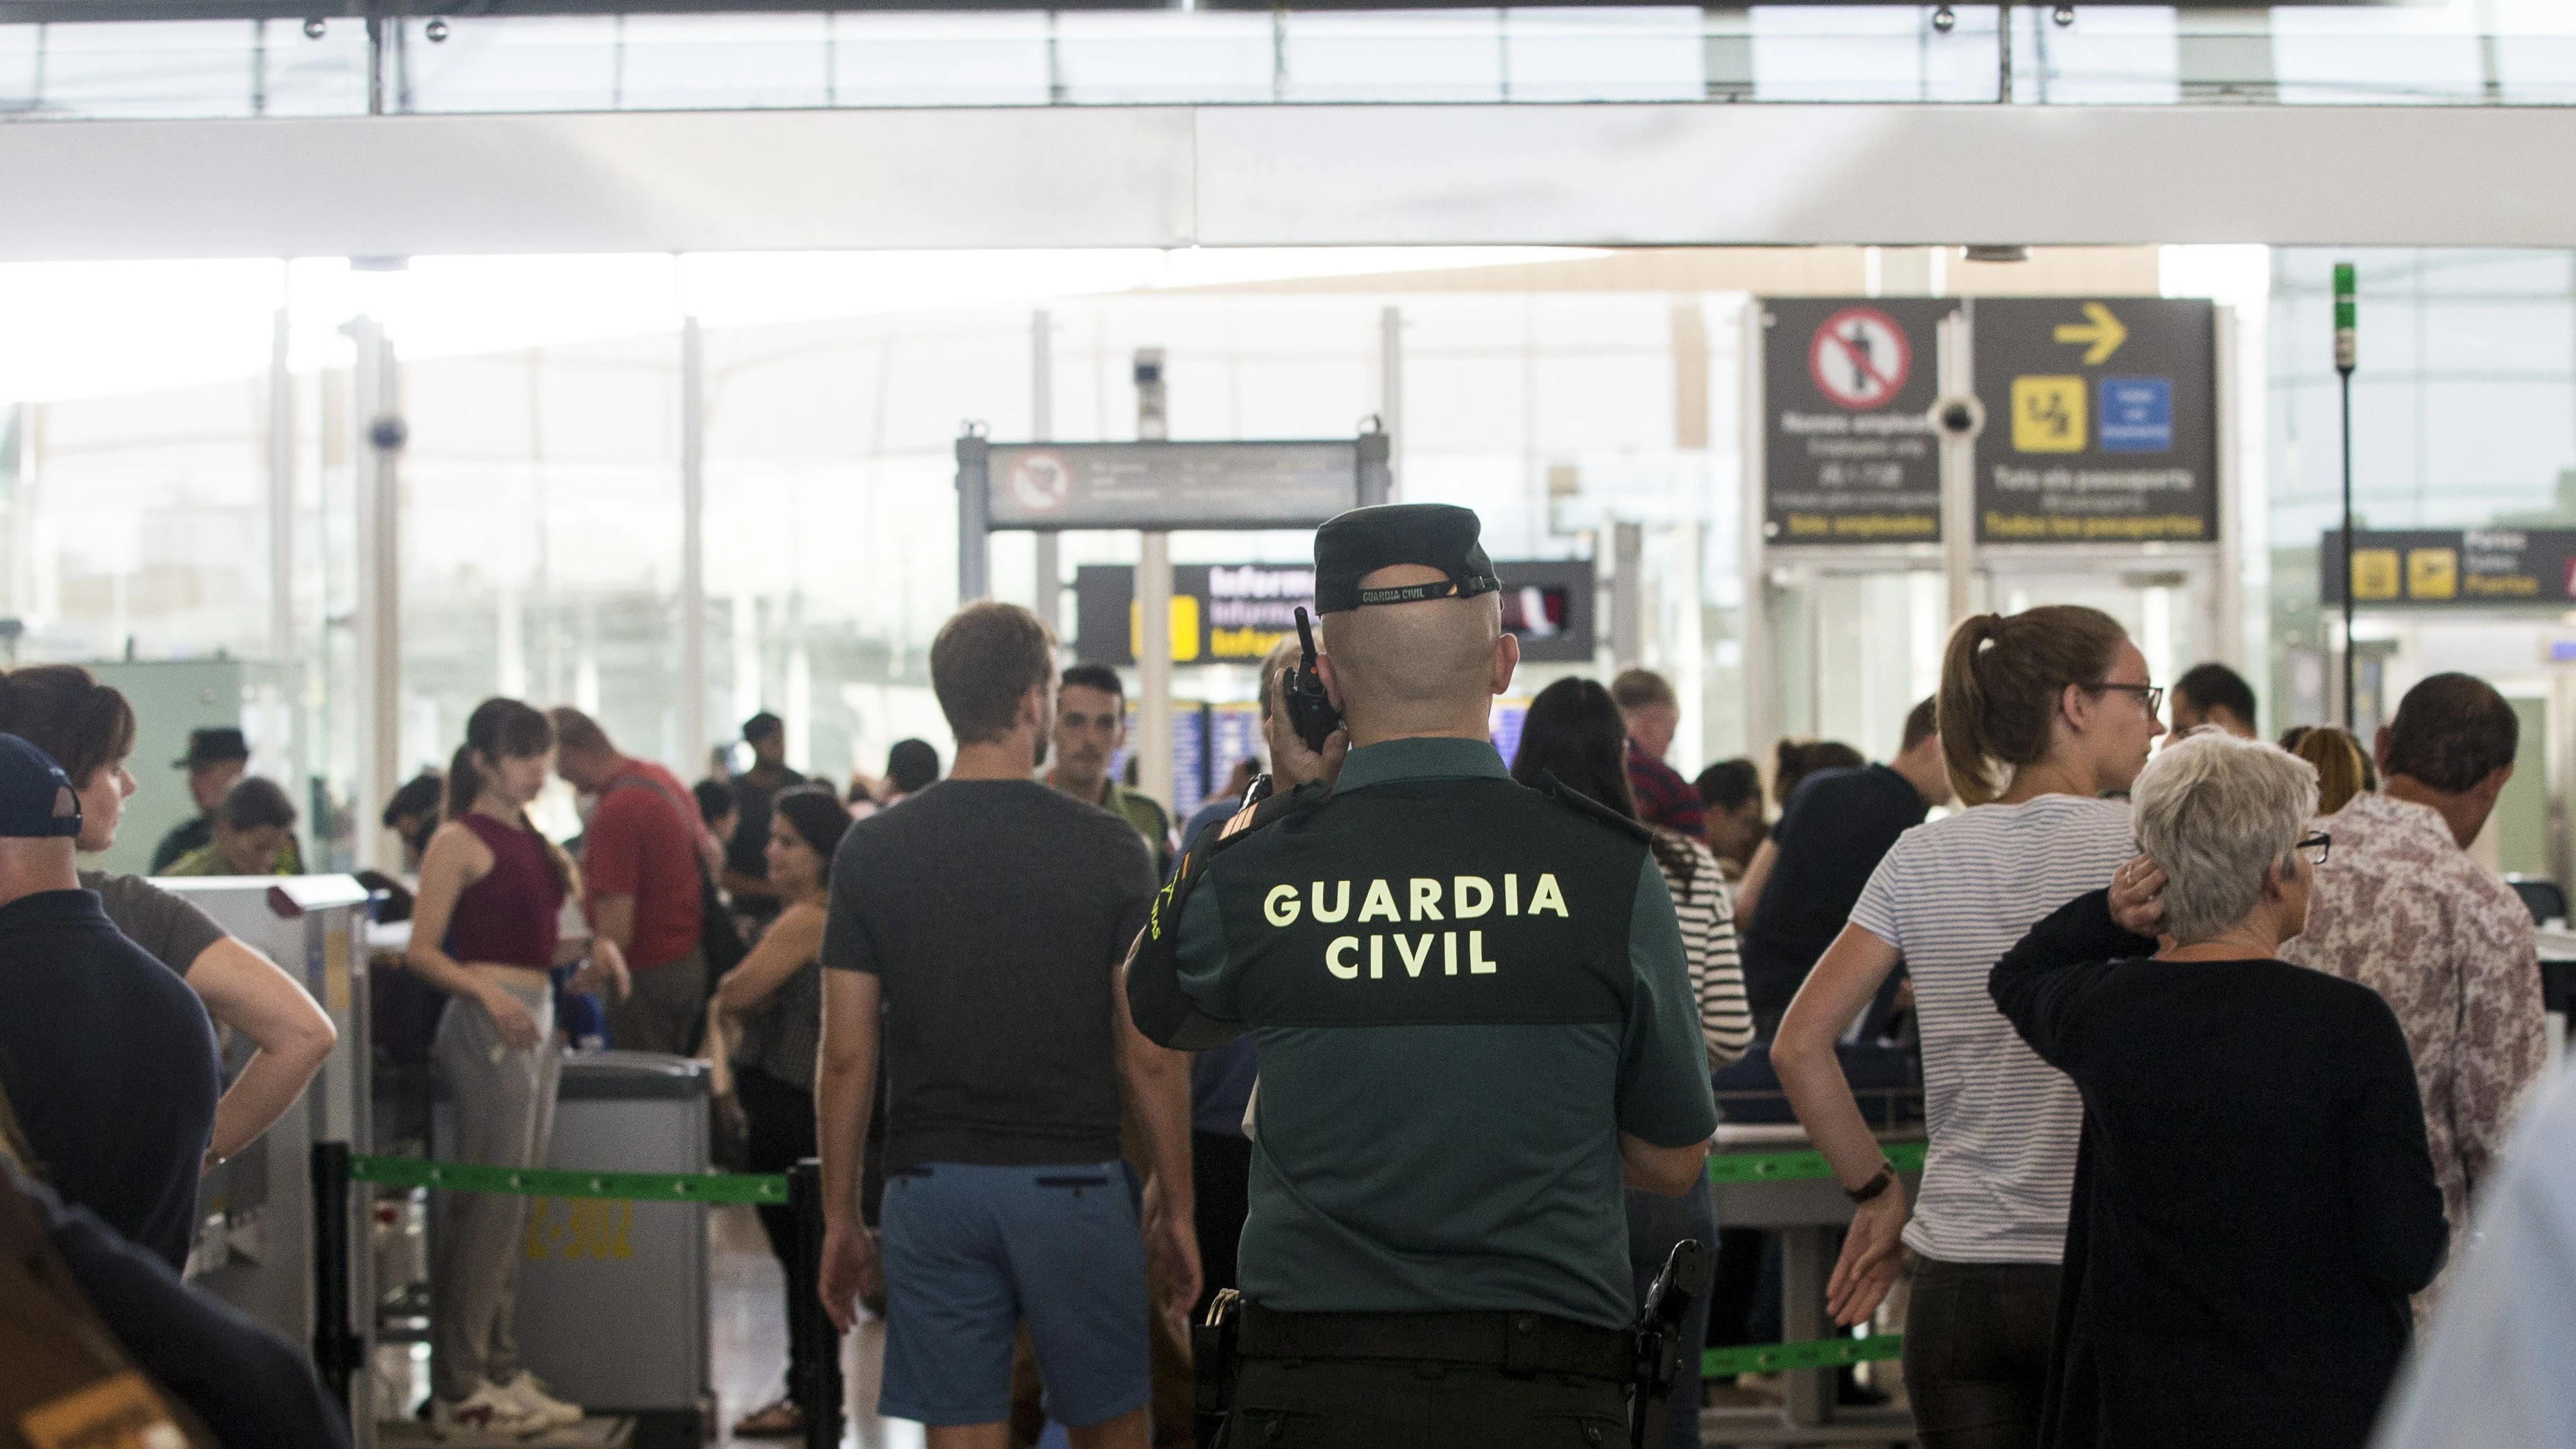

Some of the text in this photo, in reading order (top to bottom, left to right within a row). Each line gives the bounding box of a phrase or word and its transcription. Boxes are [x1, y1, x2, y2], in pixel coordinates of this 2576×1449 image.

[1363, 588, 1425, 603] GUARDIA CIVIL
[1264, 874, 1569, 927] GUARDIA
[1326, 931, 1496, 979] CIVIL
